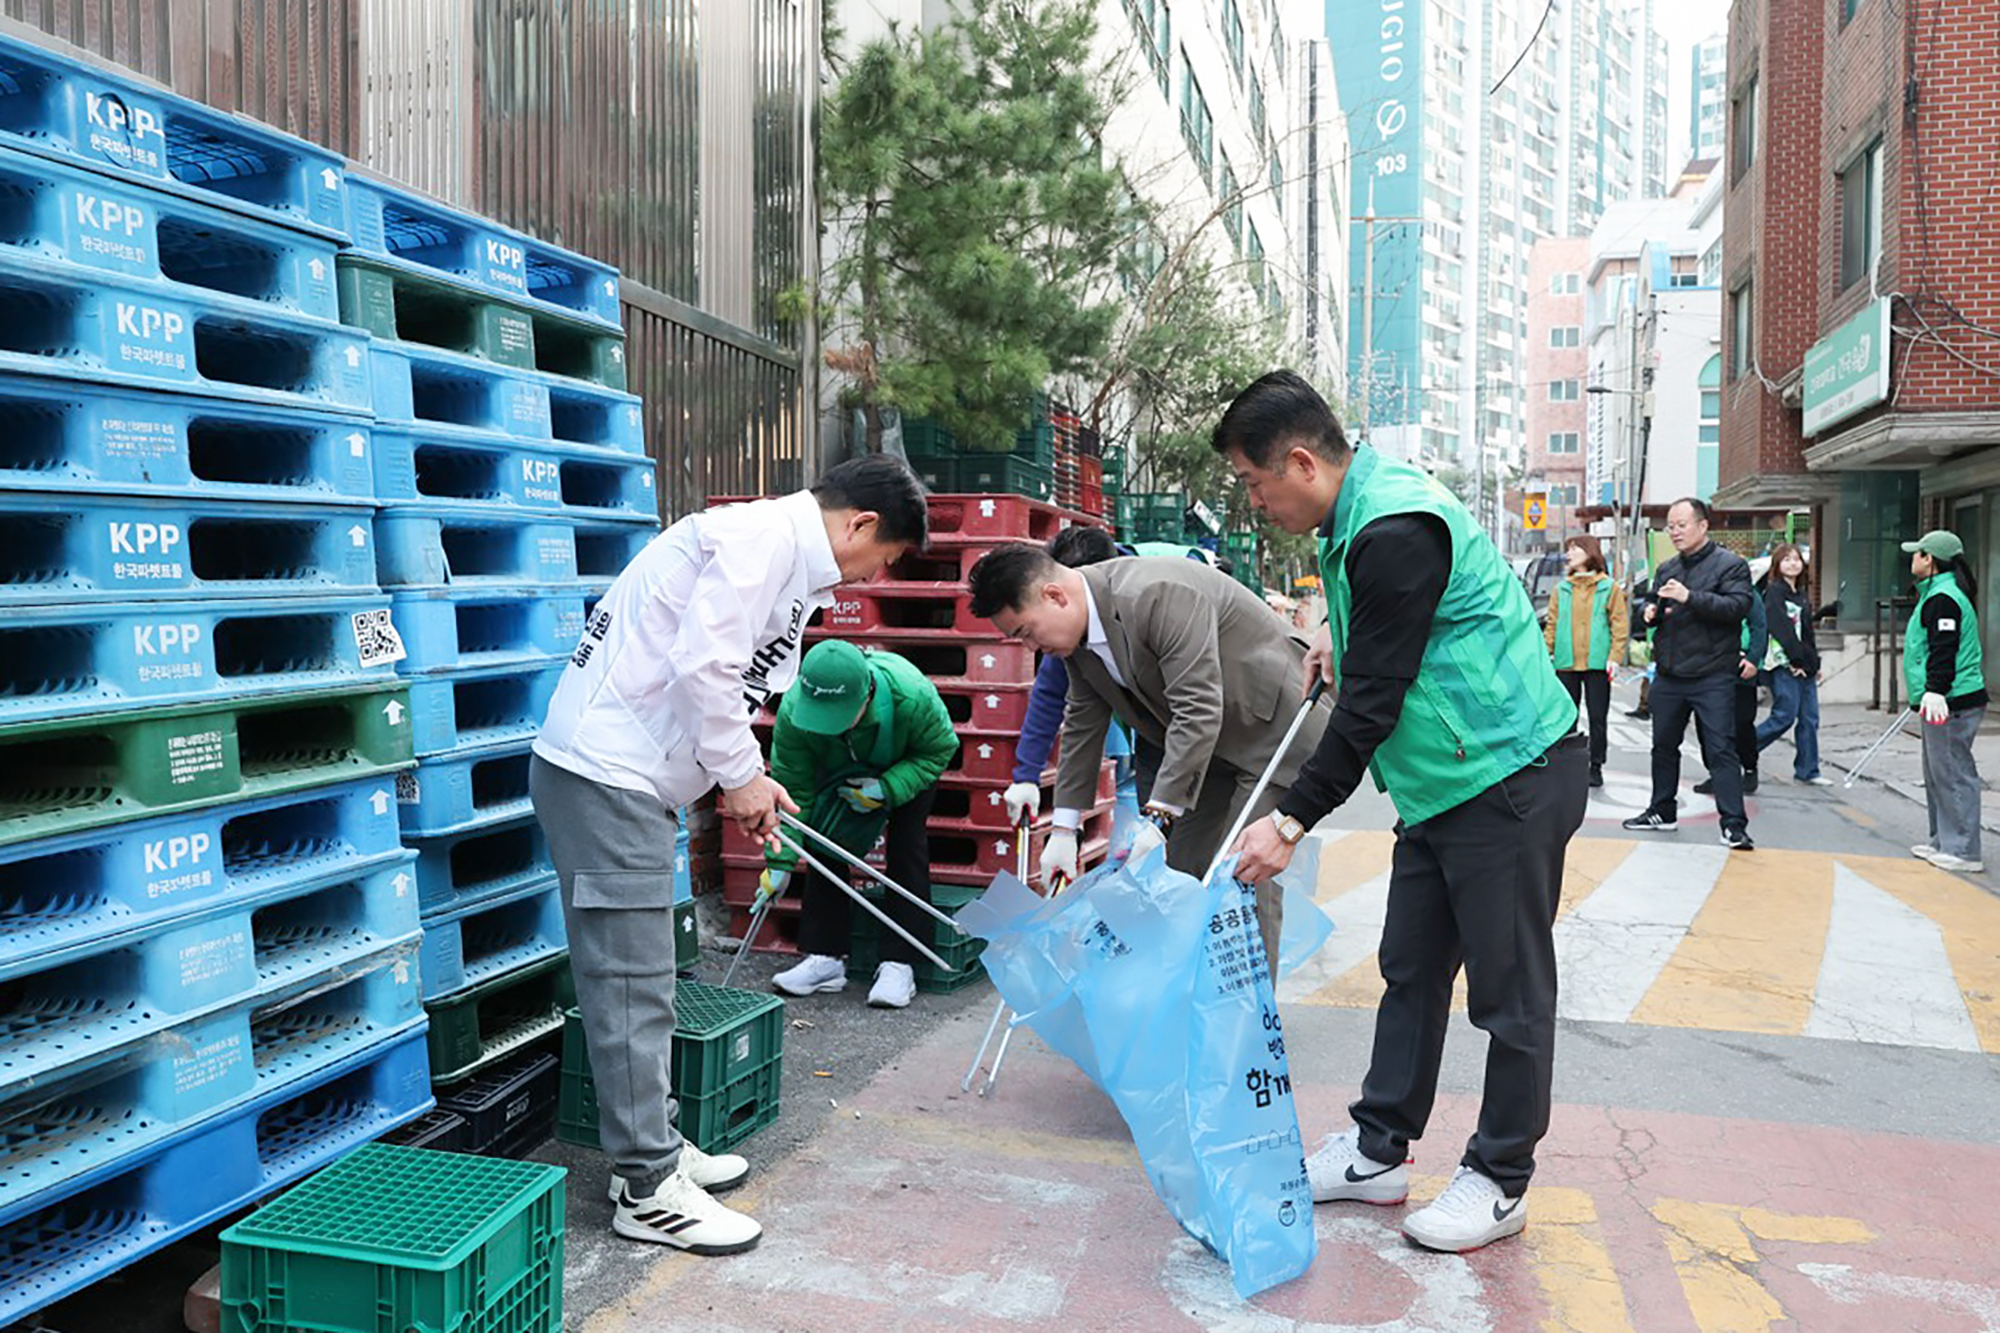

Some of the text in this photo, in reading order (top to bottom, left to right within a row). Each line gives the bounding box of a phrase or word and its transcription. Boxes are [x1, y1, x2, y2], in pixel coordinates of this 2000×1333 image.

[86, 91, 155, 138] KPP
[1375, 153, 1407, 176] 103
[76, 191, 144, 236] KPP
[487, 239, 521, 270] KPP
[117, 302, 183, 343] KPP
[522, 458, 558, 483] KPP
[109, 522, 180, 554] KPP
[134, 624, 200, 655] KPP
[144, 832, 210, 873] KPP
